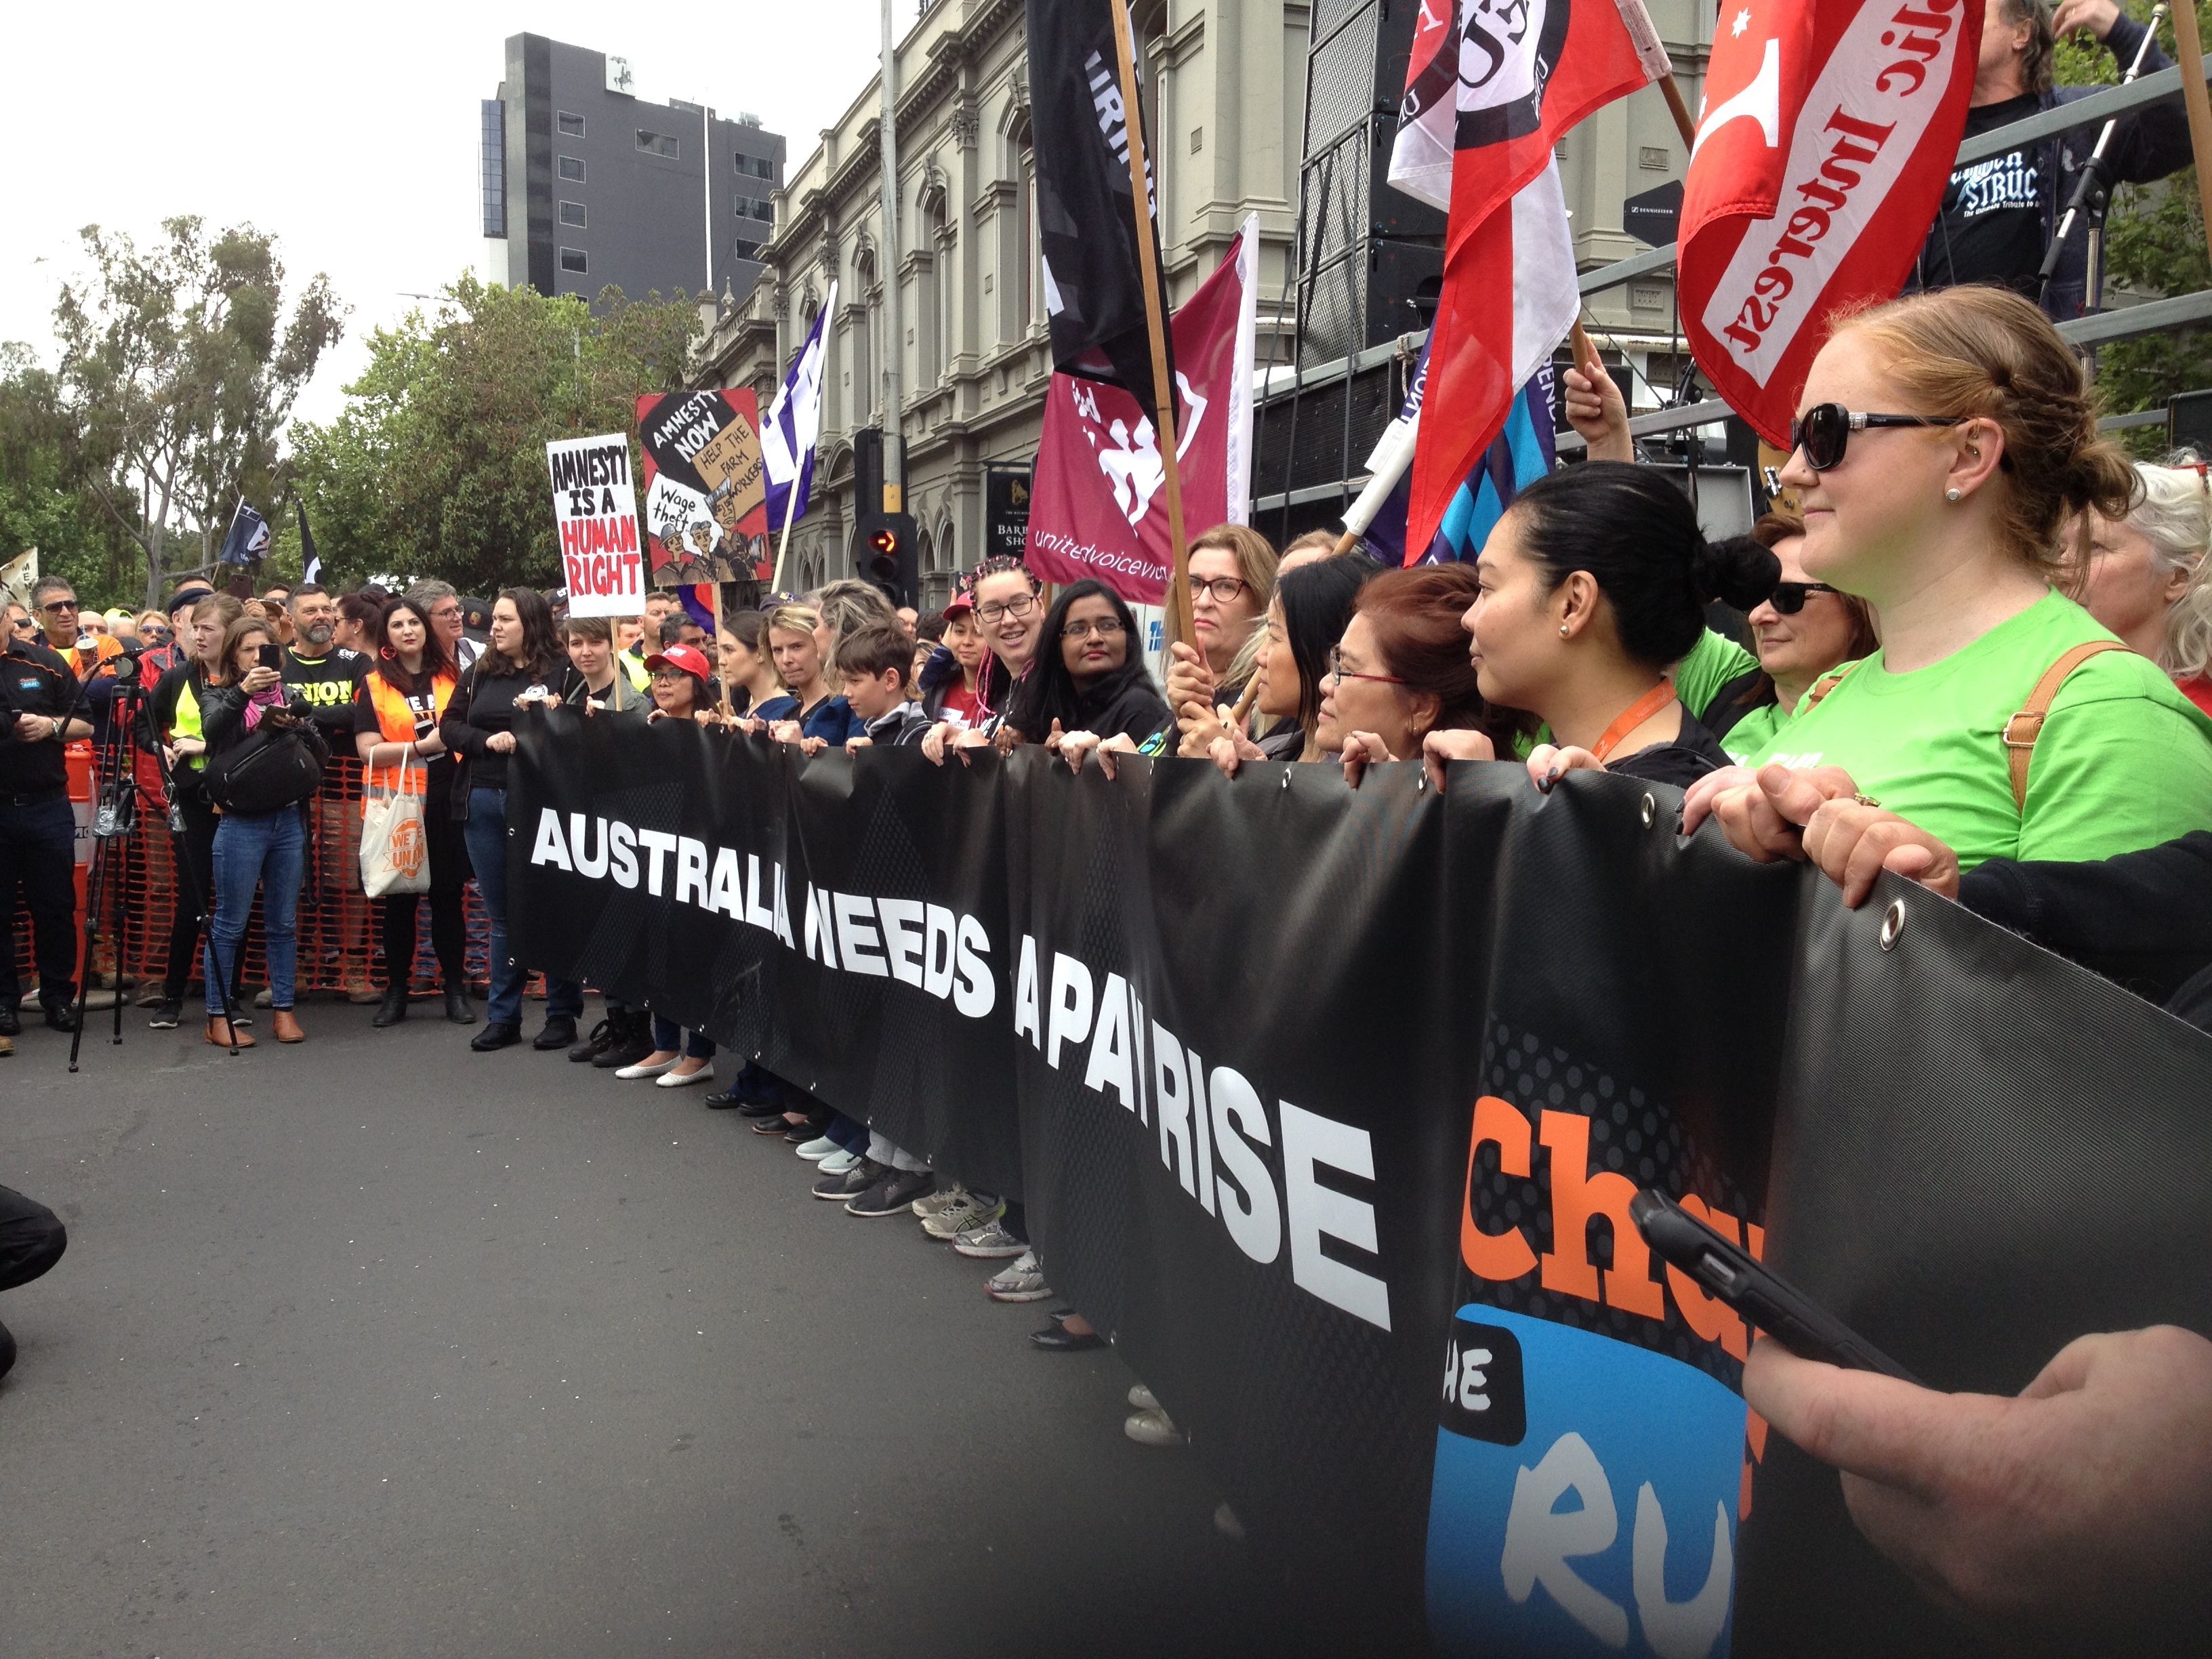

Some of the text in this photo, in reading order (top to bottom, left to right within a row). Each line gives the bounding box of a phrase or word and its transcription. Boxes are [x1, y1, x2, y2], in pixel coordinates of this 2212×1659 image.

[653, 391, 718, 449] AMNESTY
[674, 411, 720, 464] NOW
[700, 425, 750, 470] HELP THE
[720, 449, 750, 476] FARM
[552, 445, 627, 493] AMNESTY
[729, 457, 763, 499] WORKERS
[569, 487, 616, 516] IS A
[653, 502, 689, 529] theft
[661, 483, 696, 514] Wage
[562, 515, 637, 556] HUMAN
[568, 554, 640, 597] RIGHT
[287, 680, 352, 703] NION
[531, 807, 796, 950] AUSTRALIA
[804, 880, 996, 1018] NEEDS
[1152, 1017, 1392, 1333] RISE
